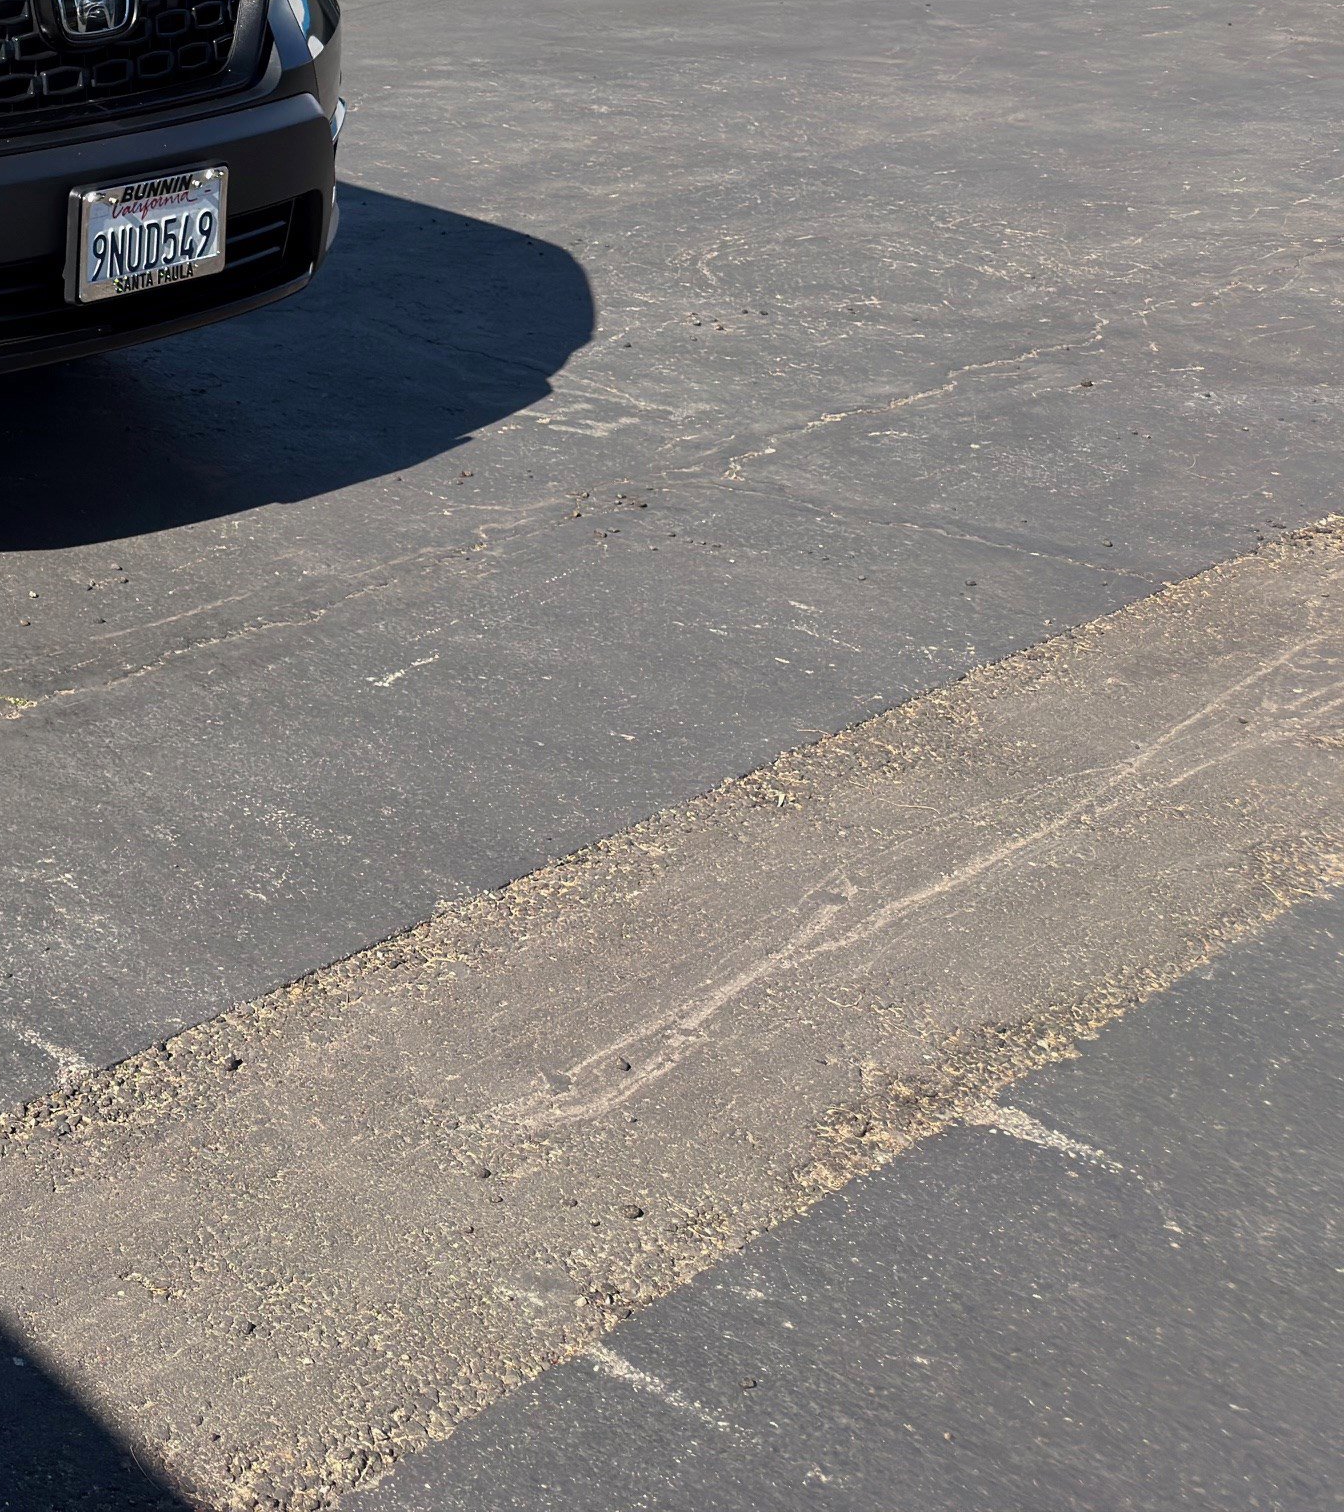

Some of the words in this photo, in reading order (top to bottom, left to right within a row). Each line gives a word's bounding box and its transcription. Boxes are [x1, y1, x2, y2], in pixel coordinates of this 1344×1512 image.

[121, 174, 193, 203] BUNNIN
[112, 190, 198, 220] California
[91, 209, 214, 282] 9NUD549
[115, 273, 154, 294] SANTA
[157, 262, 194, 285] PAULA
